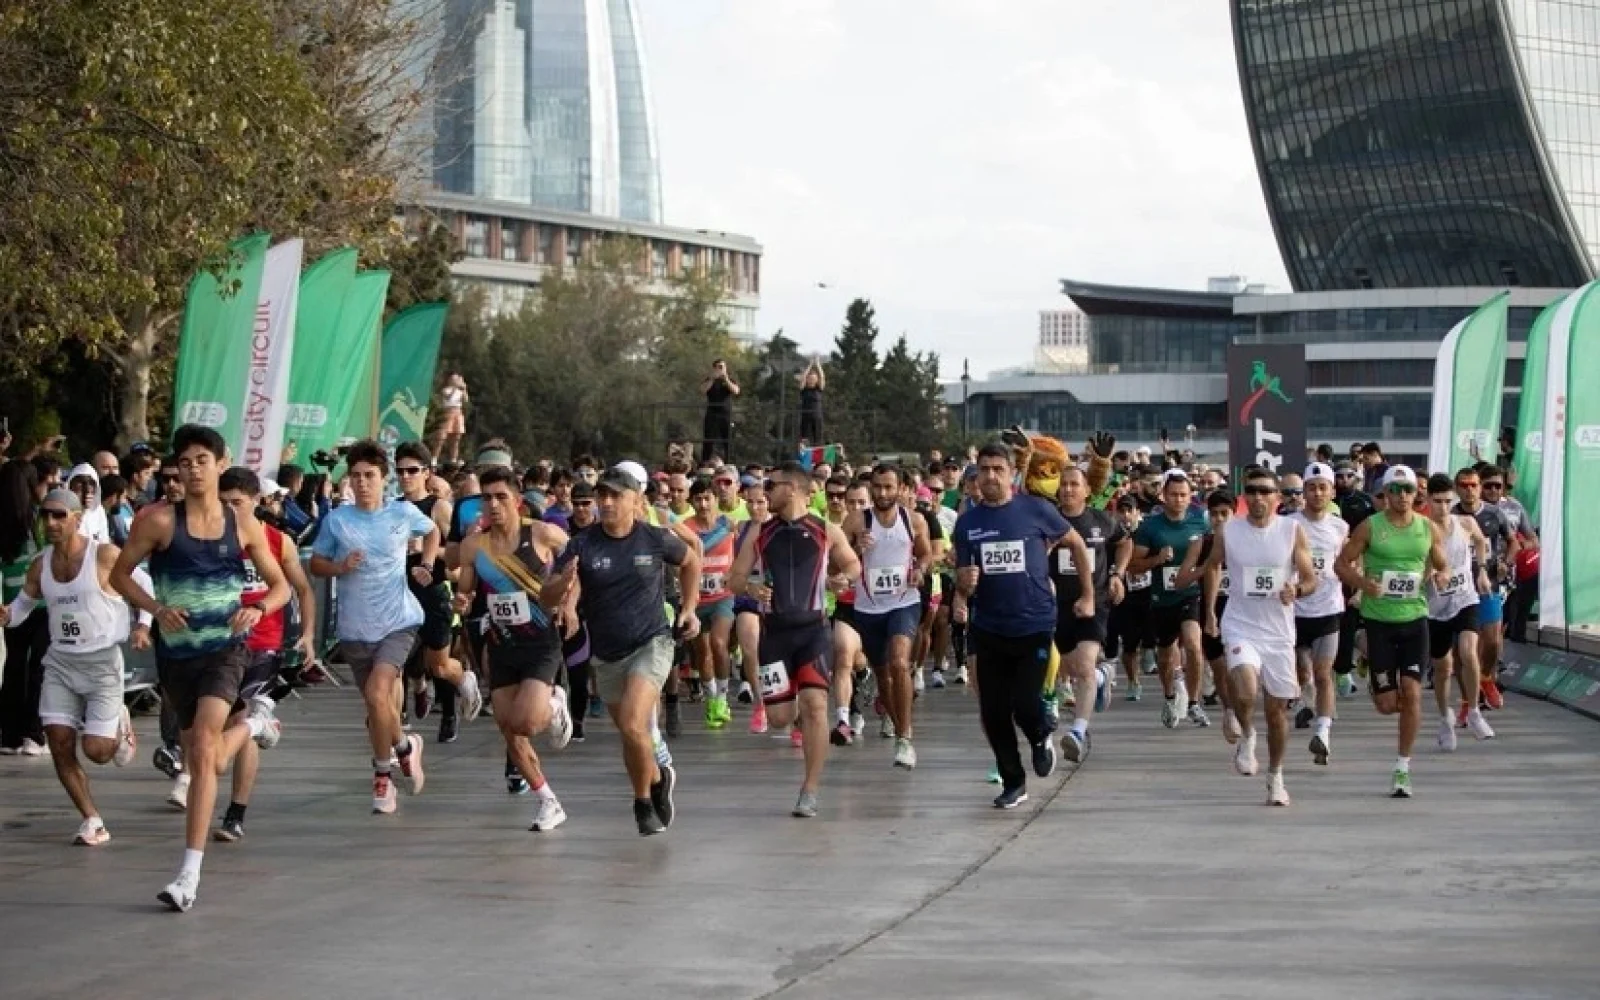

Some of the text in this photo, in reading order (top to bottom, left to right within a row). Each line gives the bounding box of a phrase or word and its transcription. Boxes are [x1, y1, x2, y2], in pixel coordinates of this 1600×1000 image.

[249, 300, 271, 386] circuit
[245, 393, 271, 442] city
[1580, 429, 1600, 443] AZ
[984, 549, 1022, 565] 2502
[875, 574, 902, 588] 415
[1255, 576, 1274, 590] 95
[1388, 578, 1415, 592] 628
[492, 601, 520, 616] 261
[61, 621, 80, 637] 96
[758, 672, 782, 687] 44
